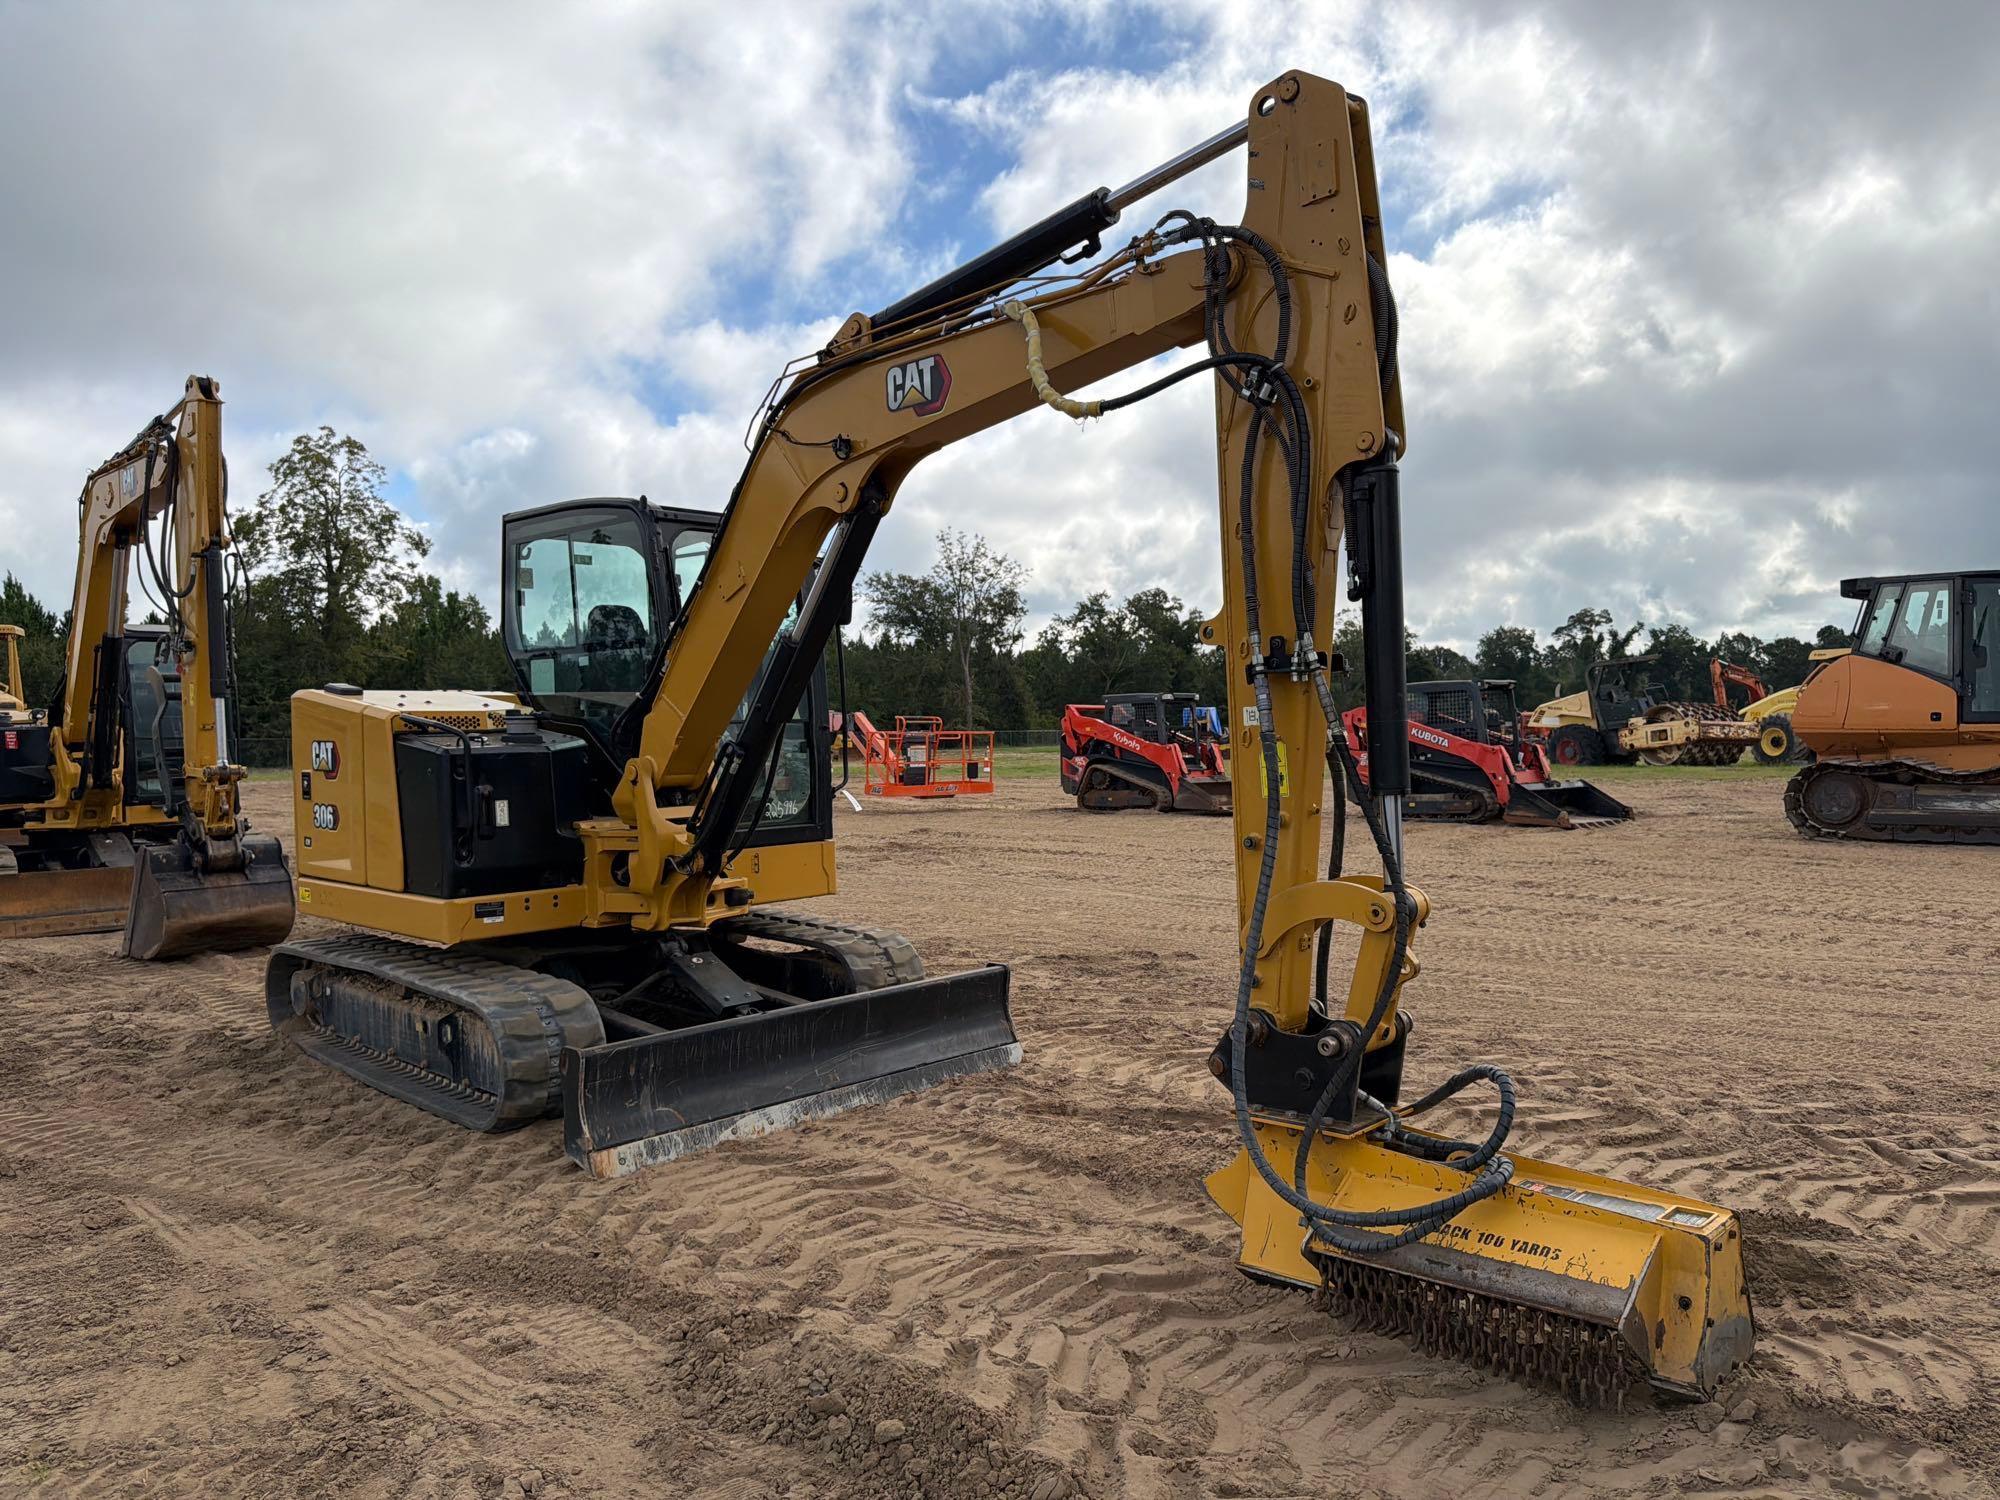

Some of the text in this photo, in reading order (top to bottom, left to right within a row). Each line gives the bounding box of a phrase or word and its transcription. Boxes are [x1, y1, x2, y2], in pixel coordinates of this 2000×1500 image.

[887, 356, 935, 410] CAT
[1112, 731, 1140, 751] Kubota
[1411, 727, 1449, 747] KUBOTA
[312, 741, 333, 770] CAT
[313, 804, 334, 829] 306
[1439, 1223, 1562, 1261] ACK 100 YARDS
